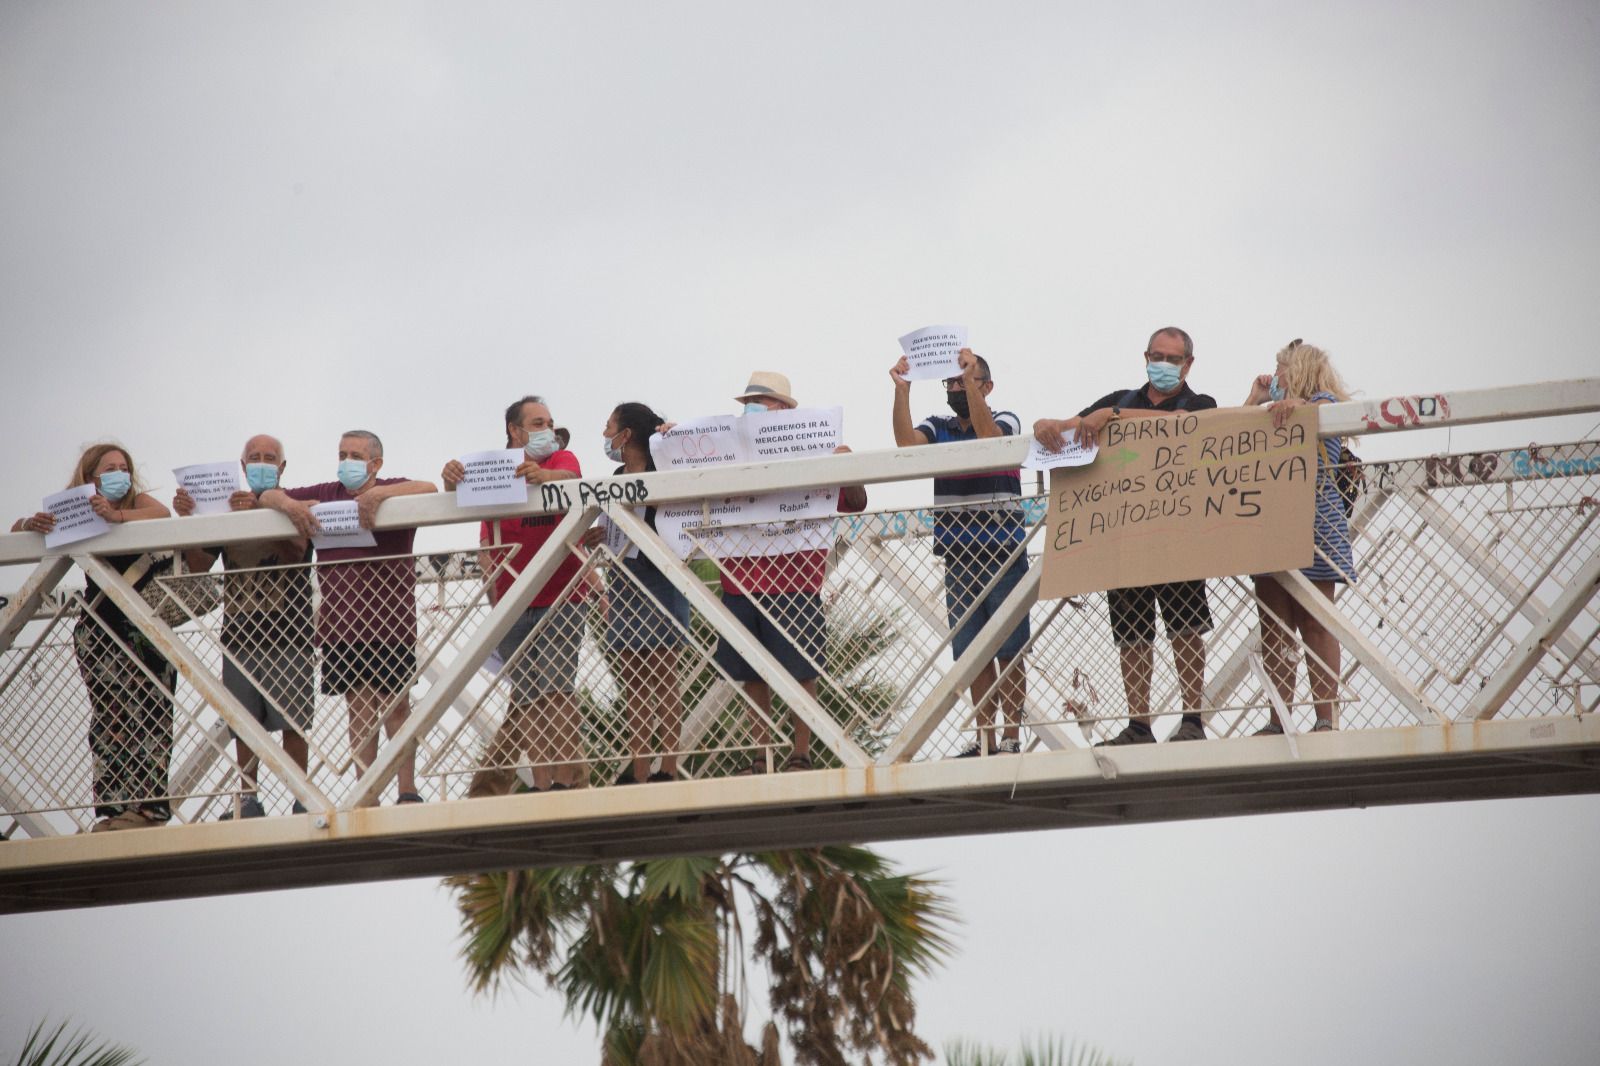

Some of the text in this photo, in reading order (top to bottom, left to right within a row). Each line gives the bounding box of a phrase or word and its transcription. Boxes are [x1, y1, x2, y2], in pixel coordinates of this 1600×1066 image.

[696, 426, 718, 434] hasta
[759, 423, 806, 434] ¡QUEREMOS
[755, 430, 836, 444] MERCADO CENTRAL!
[758, 446, 790, 455] VUELTA
[1152, 424, 1305, 470] DE RABASA
[1155, 468, 1198, 492] QUE
[1207, 456, 1307, 488] VUELVA
[708, 505, 741, 514] ambién
[779, 502, 809, 512] Rabasa
[1054, 518, 1083, 551] EL
